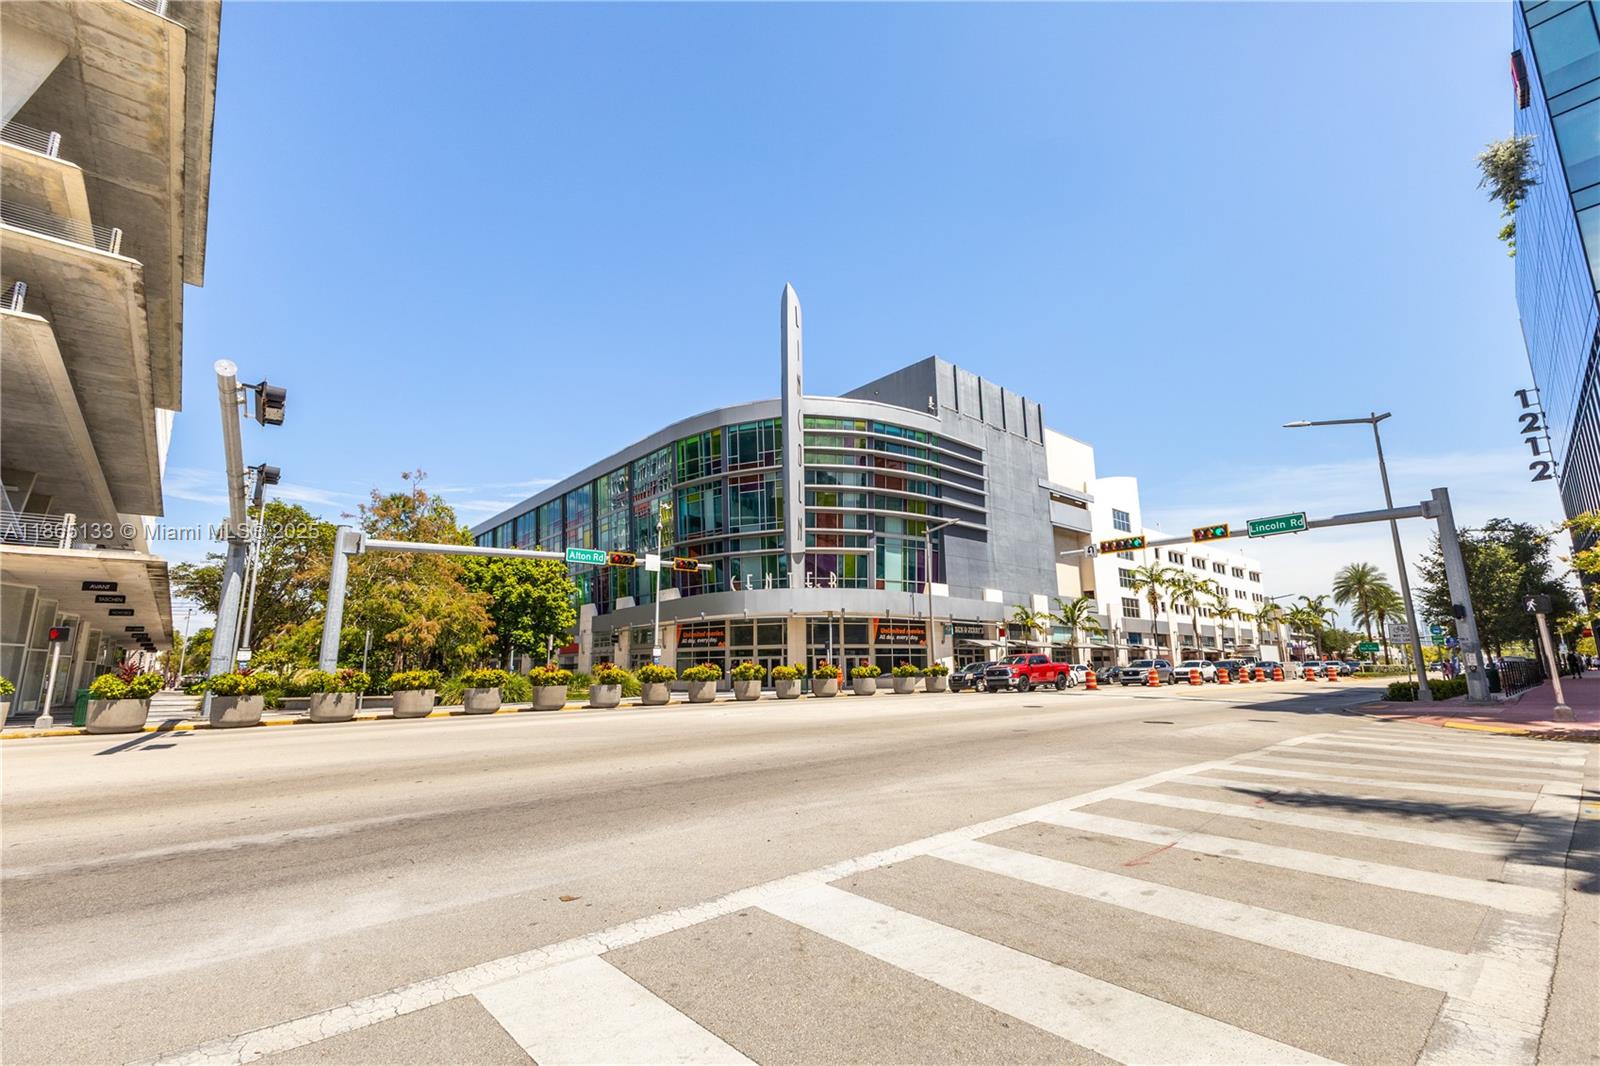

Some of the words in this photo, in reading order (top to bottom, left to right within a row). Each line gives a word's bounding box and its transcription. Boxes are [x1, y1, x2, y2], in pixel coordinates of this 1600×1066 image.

[1514, 389, 1553, 482] 1212
[1250, 521, 1286, 533] Lincoln
[1290, 518, 1303, 527] Rd
[569, 551, 591, 561] Alton
[593, 553, 604, 562] Rd
[730, 571, 837, 592] CENTER
